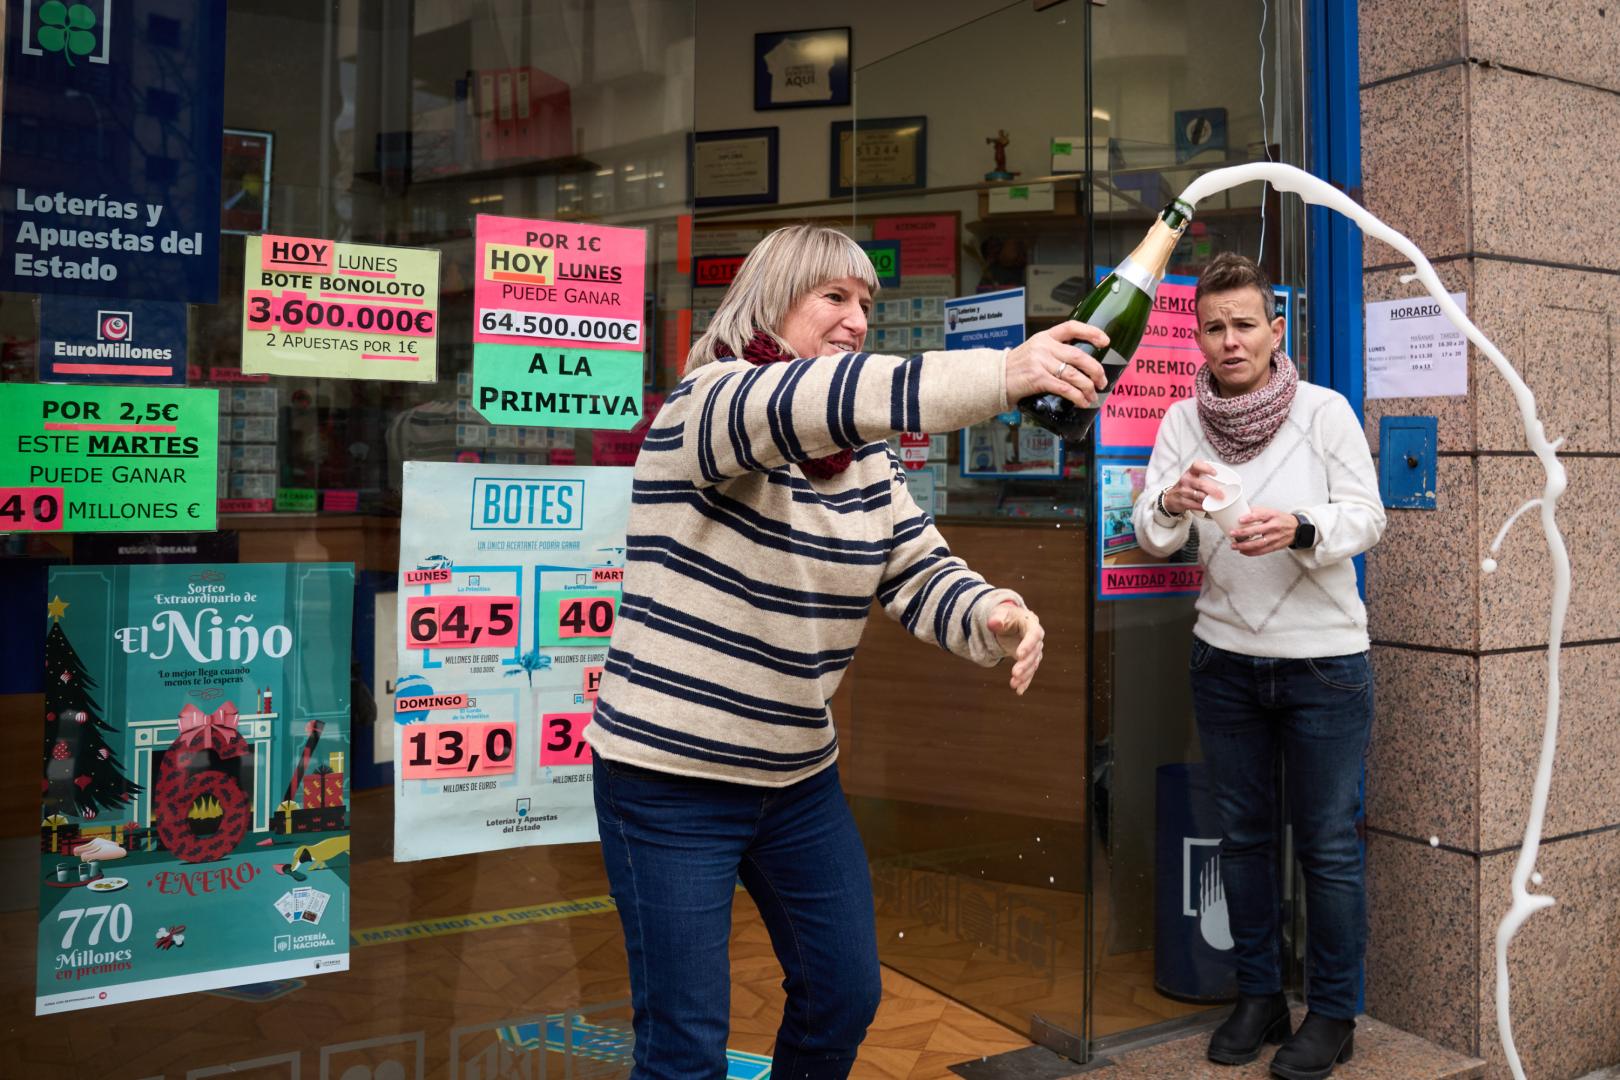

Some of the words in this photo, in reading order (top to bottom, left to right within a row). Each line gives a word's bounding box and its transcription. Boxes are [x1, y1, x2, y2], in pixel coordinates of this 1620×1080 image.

[16, 188, 138, 220] Loterías
[146, 203, 162, 227] y
[16, 221, 154, 251] Apuestas
[160, 231, 202, 255] del
[526, 232, 568, 249] POR
[578, 236, 601, 251] 1€
[272, 242, 327, 262] HOY
[339, 254, 398, 272] LUNES
[491, 250, 548, 274] HOY
[559, 263, 622, 281] LUNES
[15, 253, 117, 281] Estado
[261, 273, 312, 289] BOTE
[320, 277, 425, 296] BONOLOTO
[503, 284, 557, 302] PUEDE
[564, 289, 621, 305] GANAR
[249, 297, 433, 333] 3.600.000€
[1391, 305, 1441, 318] HORARIO
[482, 312, 637, 341] 64.500.000€
[54, 341, 172, 360] EuroMillones
[266, 333, 275, 346] 2
[283, 334, 358, 350] APUESTAS
[364, 341, 391, 352] POR
[399, 341, 418, 353] 1€
[528, 353, 548, 374] A
[559, 355, 592, 377] LA
[1136, 359, 1196, 375] PREMIO
[480, 387, 638, 416] PRIMITIVA
[43, 401, 101, 419] POR
[119, 403, 179, 424] 2,5€
[1107, 405, 1166, 419] NAVIDAD
[18, 435, 79, 453] ESTE
[89, 435, 199, 455] MARTES
[30, 466, 102, 483] PUEDE
[112, 466, 186, 483] GANAR
[0, 494, 58, 522] 40
[69, 502, 178, 519] MILLONES
[187, 502, 200, 518] €
[483, 484, 573, 524] BOTES
[408, 571, 448, 582] LUNES
[1108, 573, 1165, 587] NAVIDAD
[1169, 571, 1204, 585] 2017
[154, 593, 240, 604] Extraordinario
[244, 592, 257, 602] de
[188, 583, 225, 594] Sorteo
[410, 603, 513, 644] 64,5
[560, 600, 613, 633] 40
[114, 626, 148, 653] El
[150, 608, 292, 664] Niño
[445, 655, 472, 664] MILLONES
[554, 655, 579, 663] MILLONES
[587, 654, 604, 662] EUROS
[158, 670, 169, 678] Lo
[173, 669, 196, 678] mejor
[199, 668, 218, 676] llega
[221, 666, 250, 675] cuando
[214, 676, 244, 685] esperas
[400, 696, 462, 709] DOMINGO
[409, 728, 513, 772] 13,0
[443, 783, 469, 792] MILLONES
[471, 783, 478, 791] DE
[478, 781, 497, 790] EUROS
[553, 775, 578, 784] MILLONES
[579, 774, 585, 782] DE
[486, 817, 516, 826] Loterías
[524, 814, 558, 823] Apuestas
[503, 825, 514, 833] del
[516, 823, 541, 832] Estado
[58, 903, 133, 949] 770
[293, 932, 327, 942] LOTERÍA
[293, 938, 335, 950] NACIONAL
[56, 949, 132, 970] Millones
[56, 969, 72, 980] en
[76, 961, 132, 980] premios
